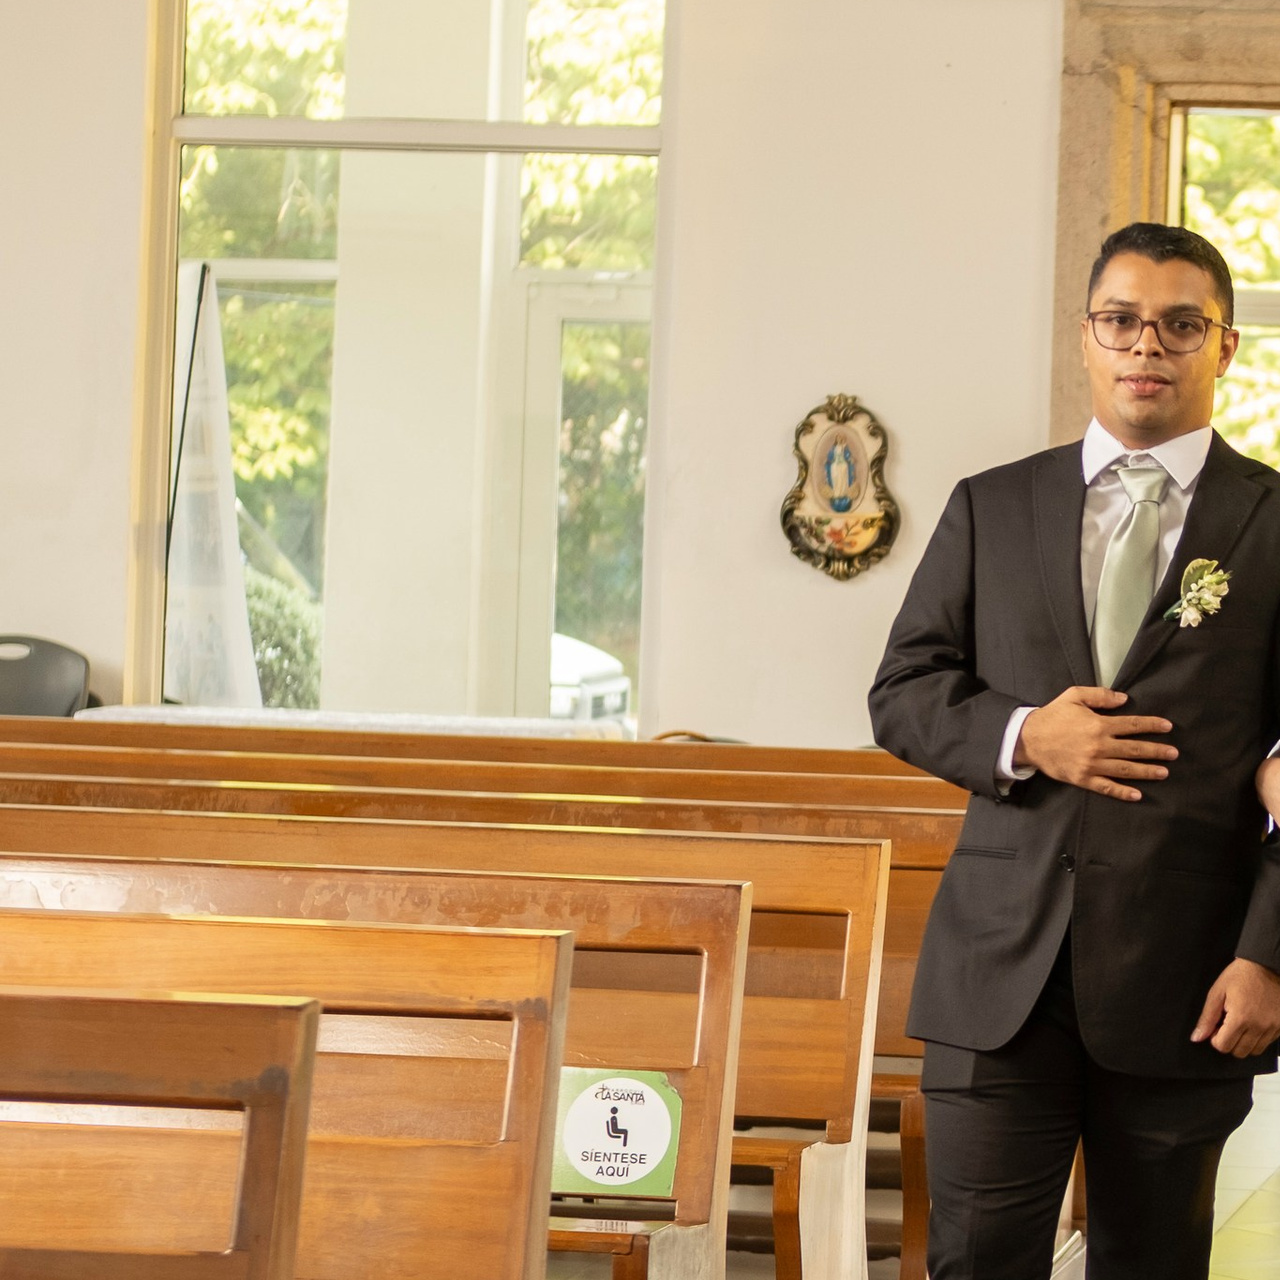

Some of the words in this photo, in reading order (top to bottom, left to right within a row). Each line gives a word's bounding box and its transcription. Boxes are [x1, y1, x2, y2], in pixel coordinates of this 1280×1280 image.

[613, 1092, 645, 1103] SANTA
[581, 1148, 647, 1165] SÍENTESE
[595, 1164, 630, 1178] AQUÍ
